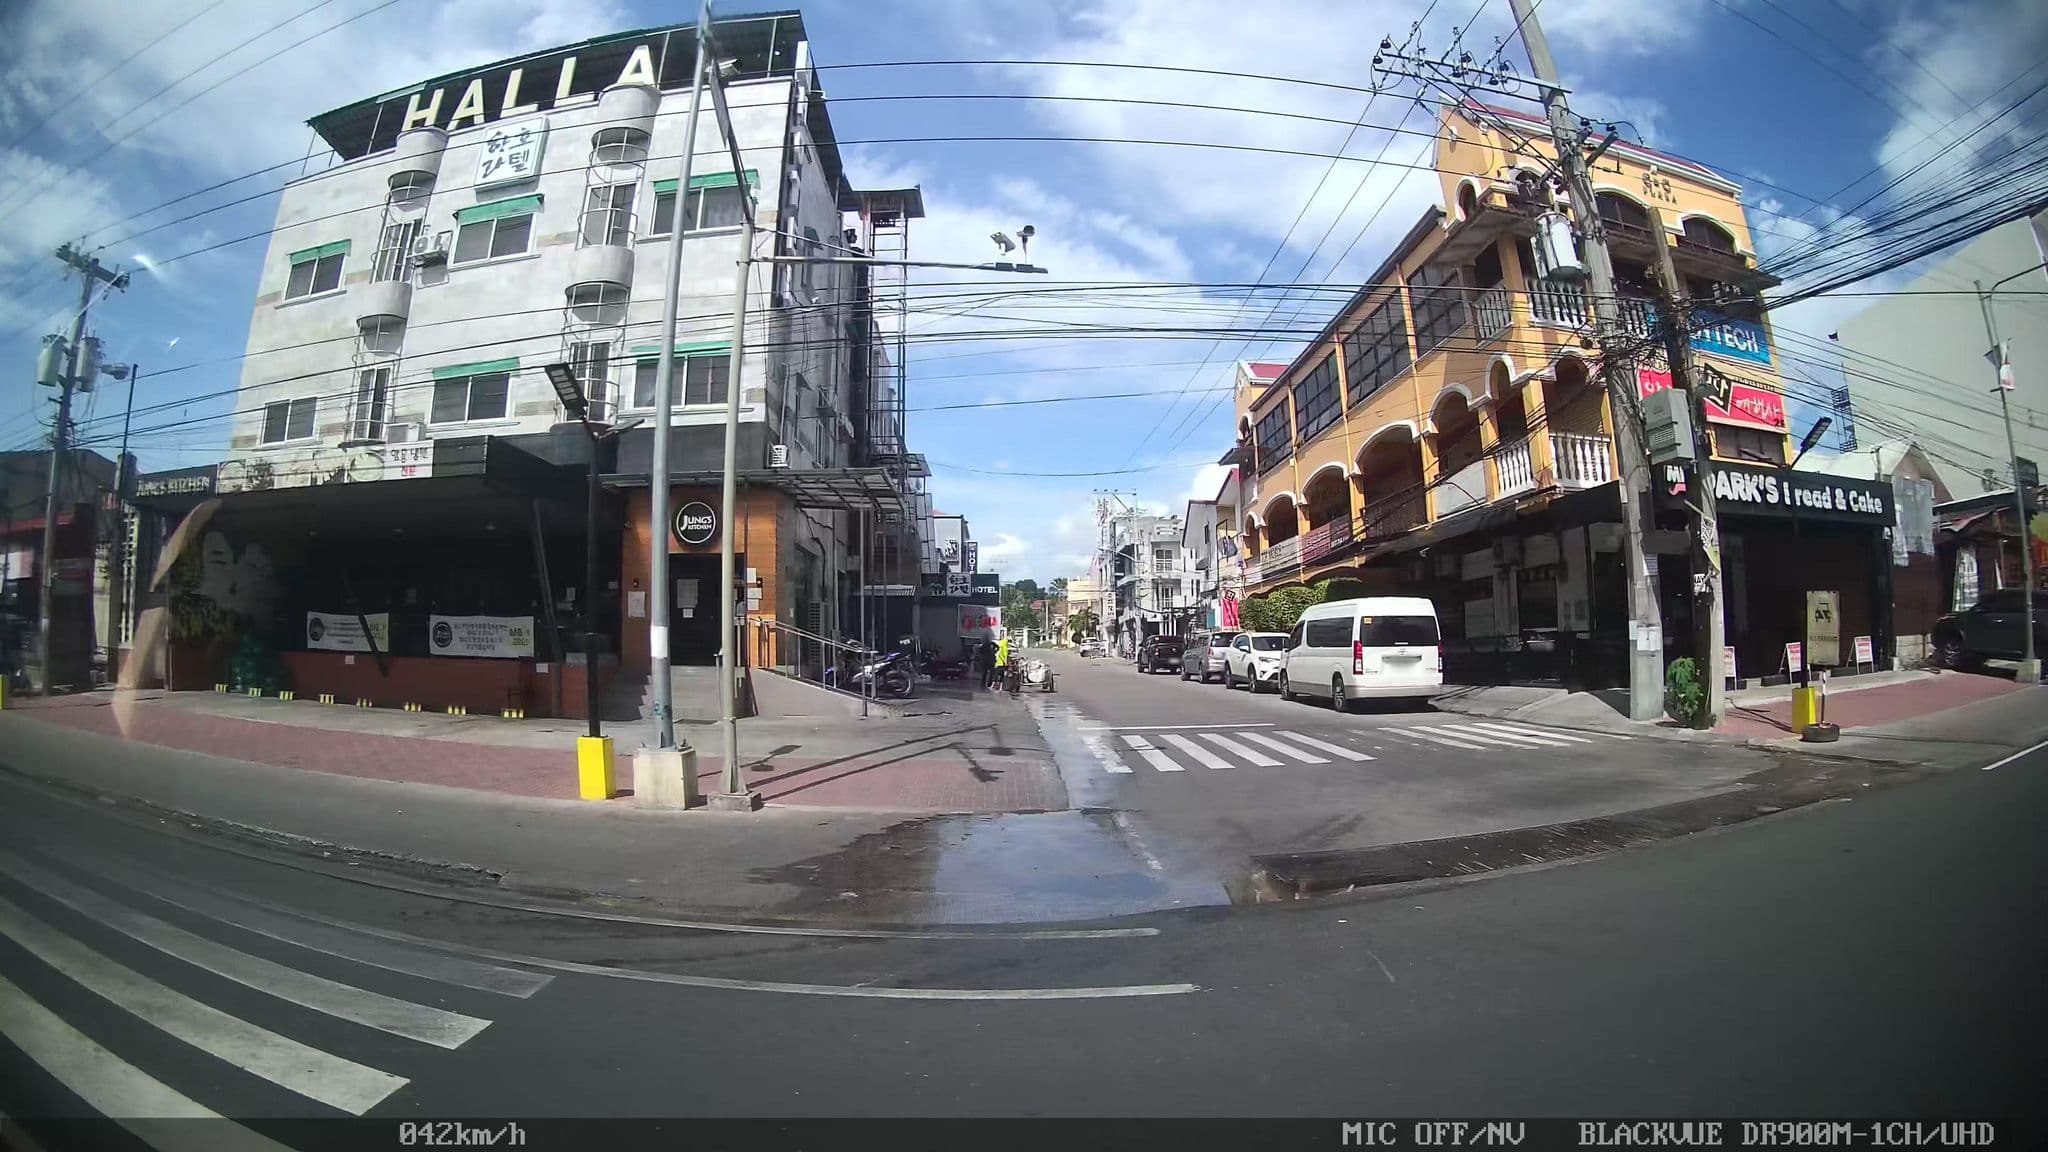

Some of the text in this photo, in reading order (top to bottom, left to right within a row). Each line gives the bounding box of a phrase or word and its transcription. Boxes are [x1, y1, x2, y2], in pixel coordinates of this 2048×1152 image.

[401, 44, 657, 132] HALLA
[1710, 470, 1779, 504] ARK'S
[1835, 487, 1847, 511] &
[1849, 489, 1883, 514] Cake
[971, 586, 998, 594] HOTEL
